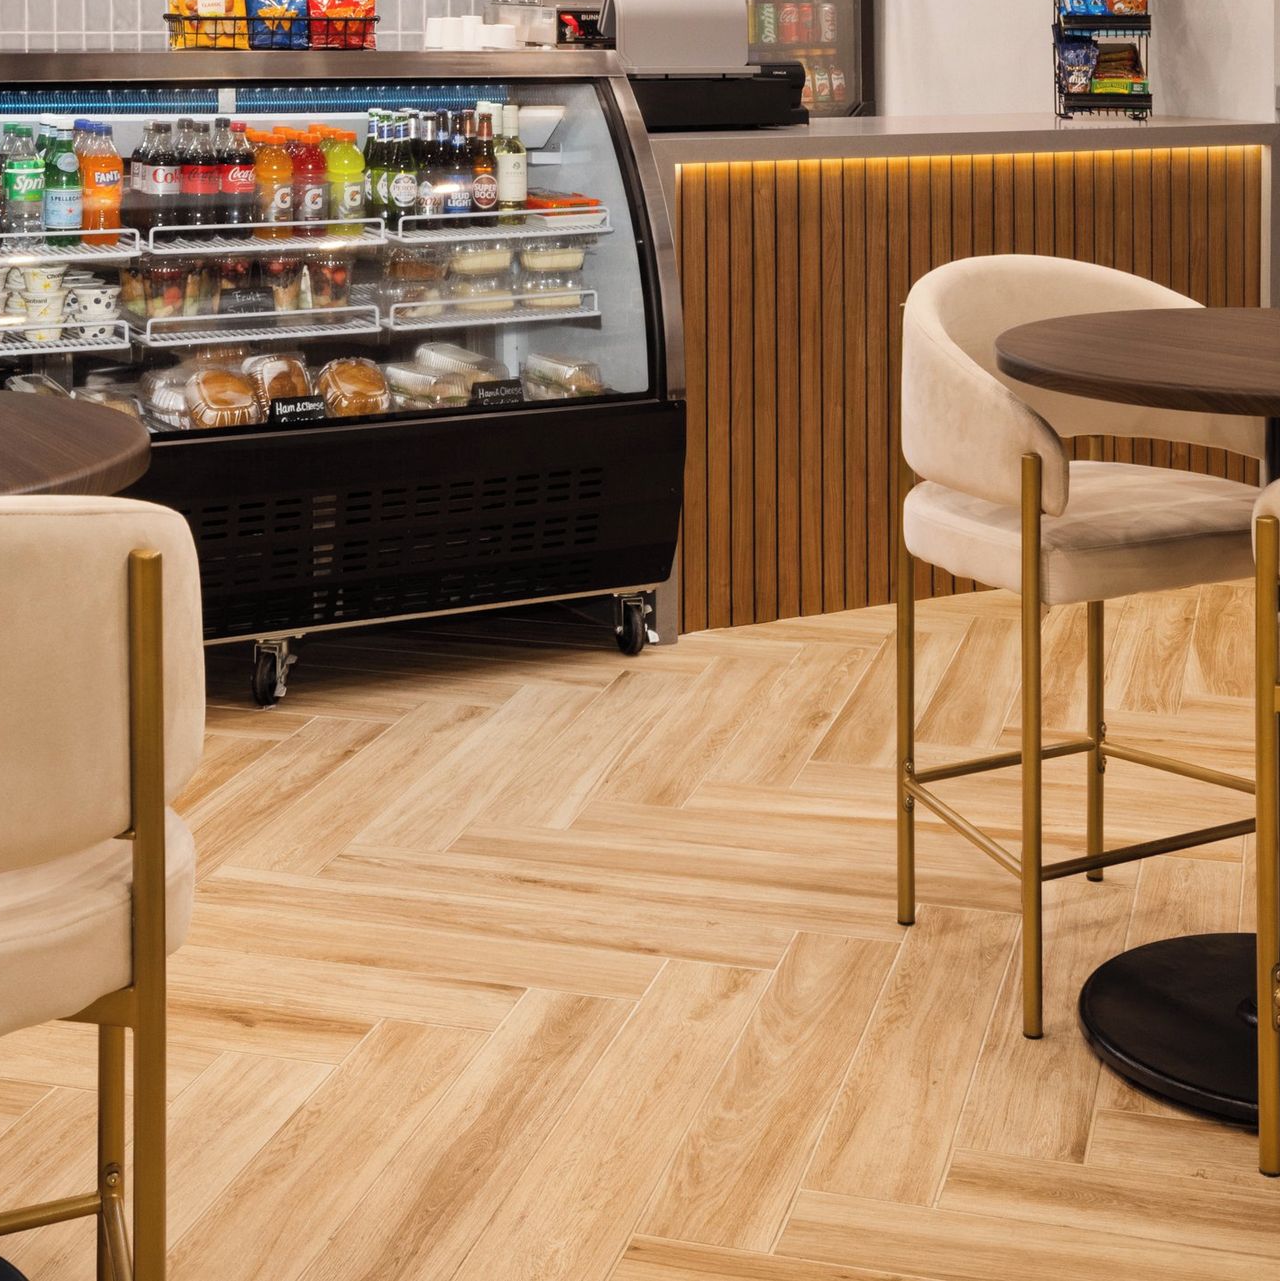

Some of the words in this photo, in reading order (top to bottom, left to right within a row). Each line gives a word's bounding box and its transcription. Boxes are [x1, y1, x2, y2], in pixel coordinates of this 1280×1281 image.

[275, 186, 291, 208] G
[305, 188, 322, 209] G
[344, 185, 361, 206] G
[475, 190, 496, 199] BOCK
[232, 290, 267, 302] Fruit
[276, 402, 295, 415] Ham
